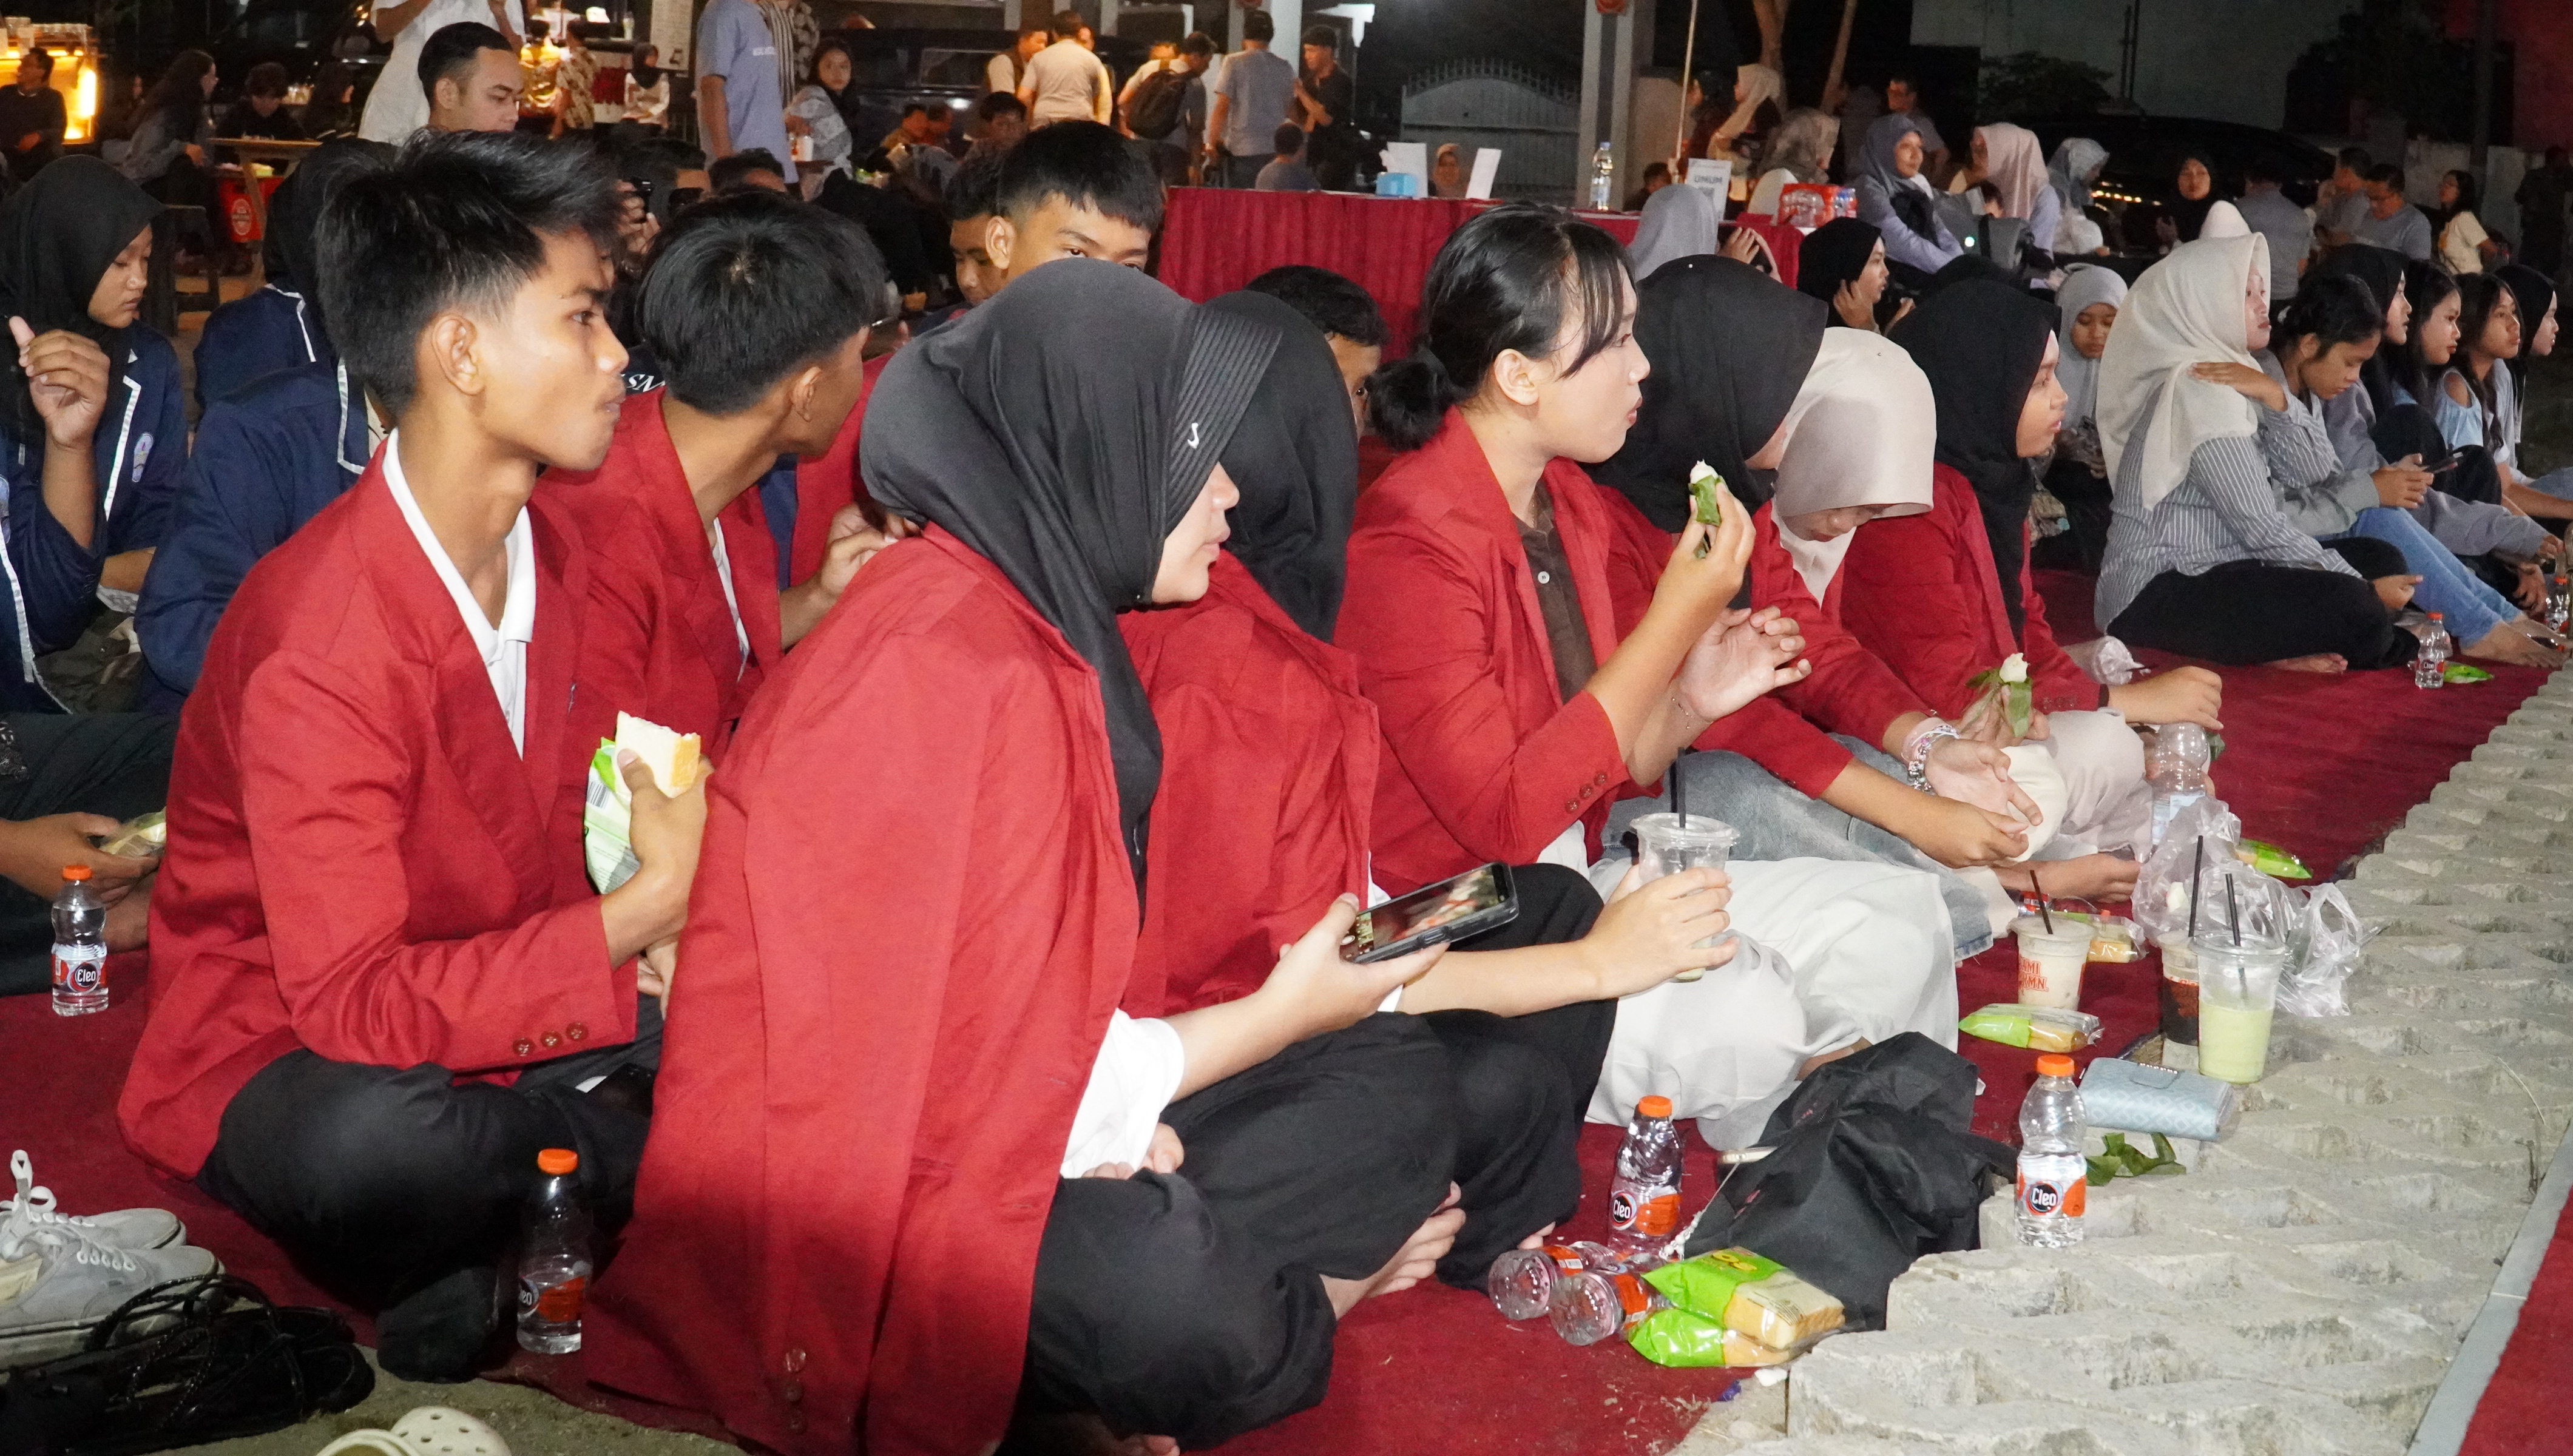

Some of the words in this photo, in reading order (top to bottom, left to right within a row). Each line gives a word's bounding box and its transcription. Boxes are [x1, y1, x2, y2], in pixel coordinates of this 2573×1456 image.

[77, 969, 96, 982] Cleo
[2032, 1188, 2057, 1207] Cleo
[1614, 1199, 1631, 1219] Cleo
